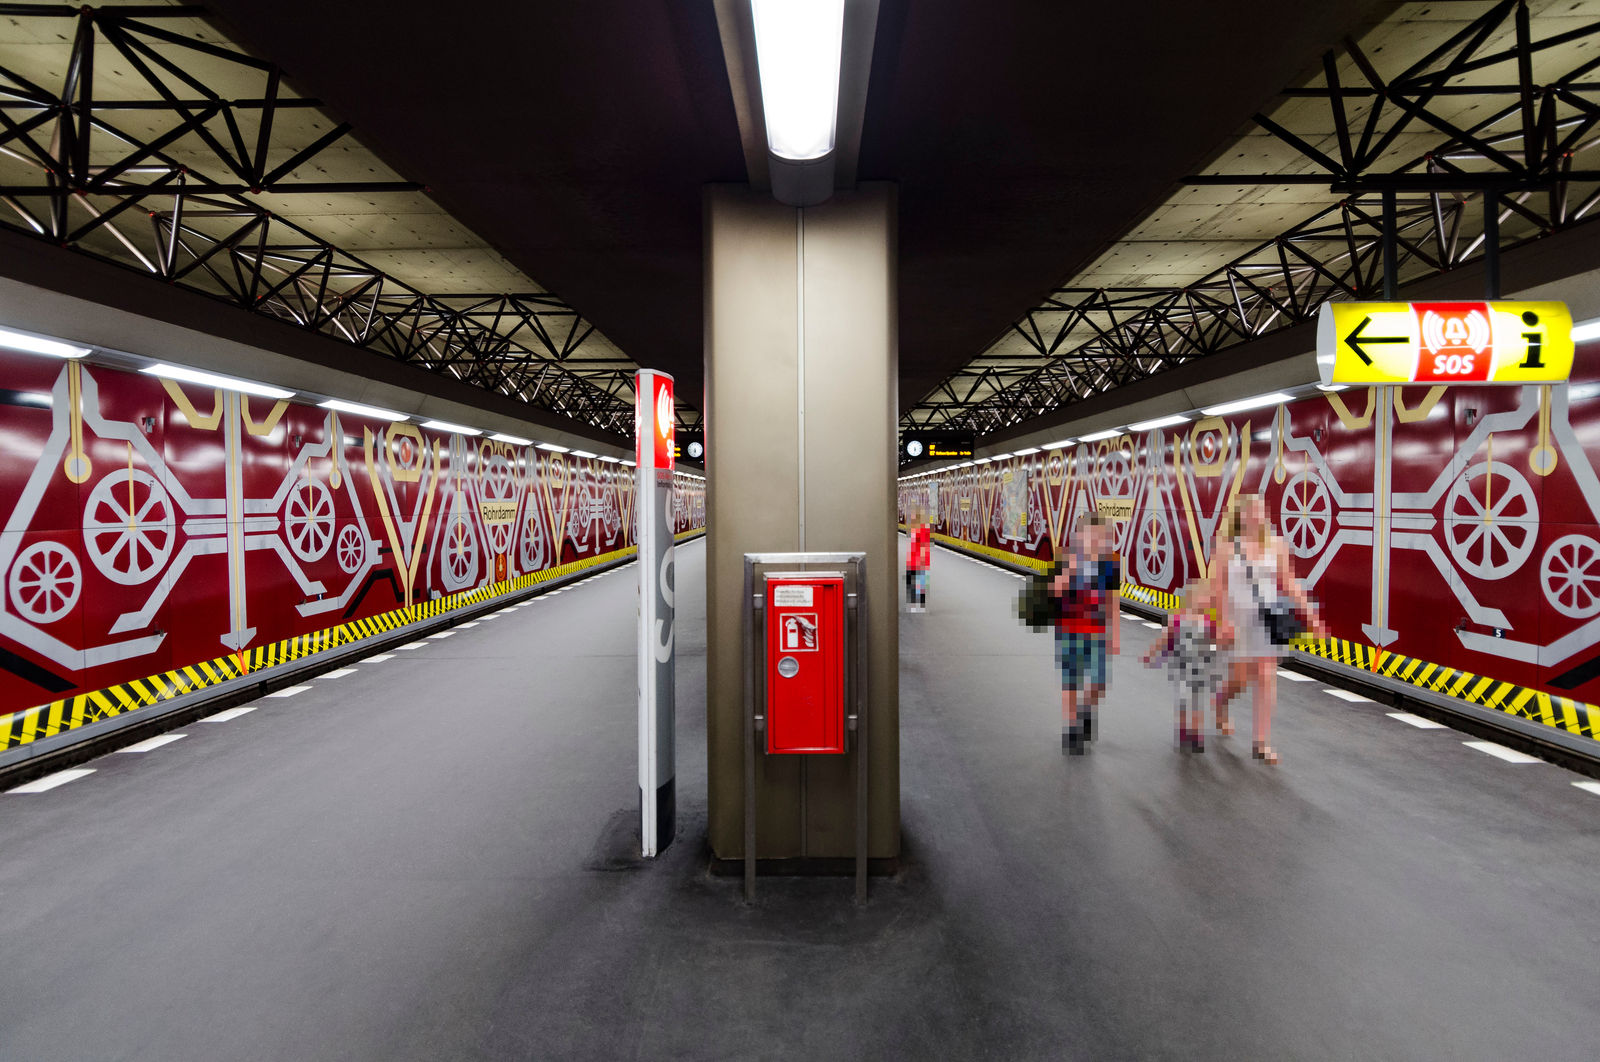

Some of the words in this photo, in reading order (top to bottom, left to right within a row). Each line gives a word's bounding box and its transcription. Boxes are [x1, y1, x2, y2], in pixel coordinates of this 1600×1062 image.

[1519, 311, 1545, 368] i
[1433, 355, 1474, 375] SOS
[483, 506, 515, 520] Rohrdamm
[1099, 502, 1131, 517] Rohrdamm
[1495, 628, 1502, 638] 5
